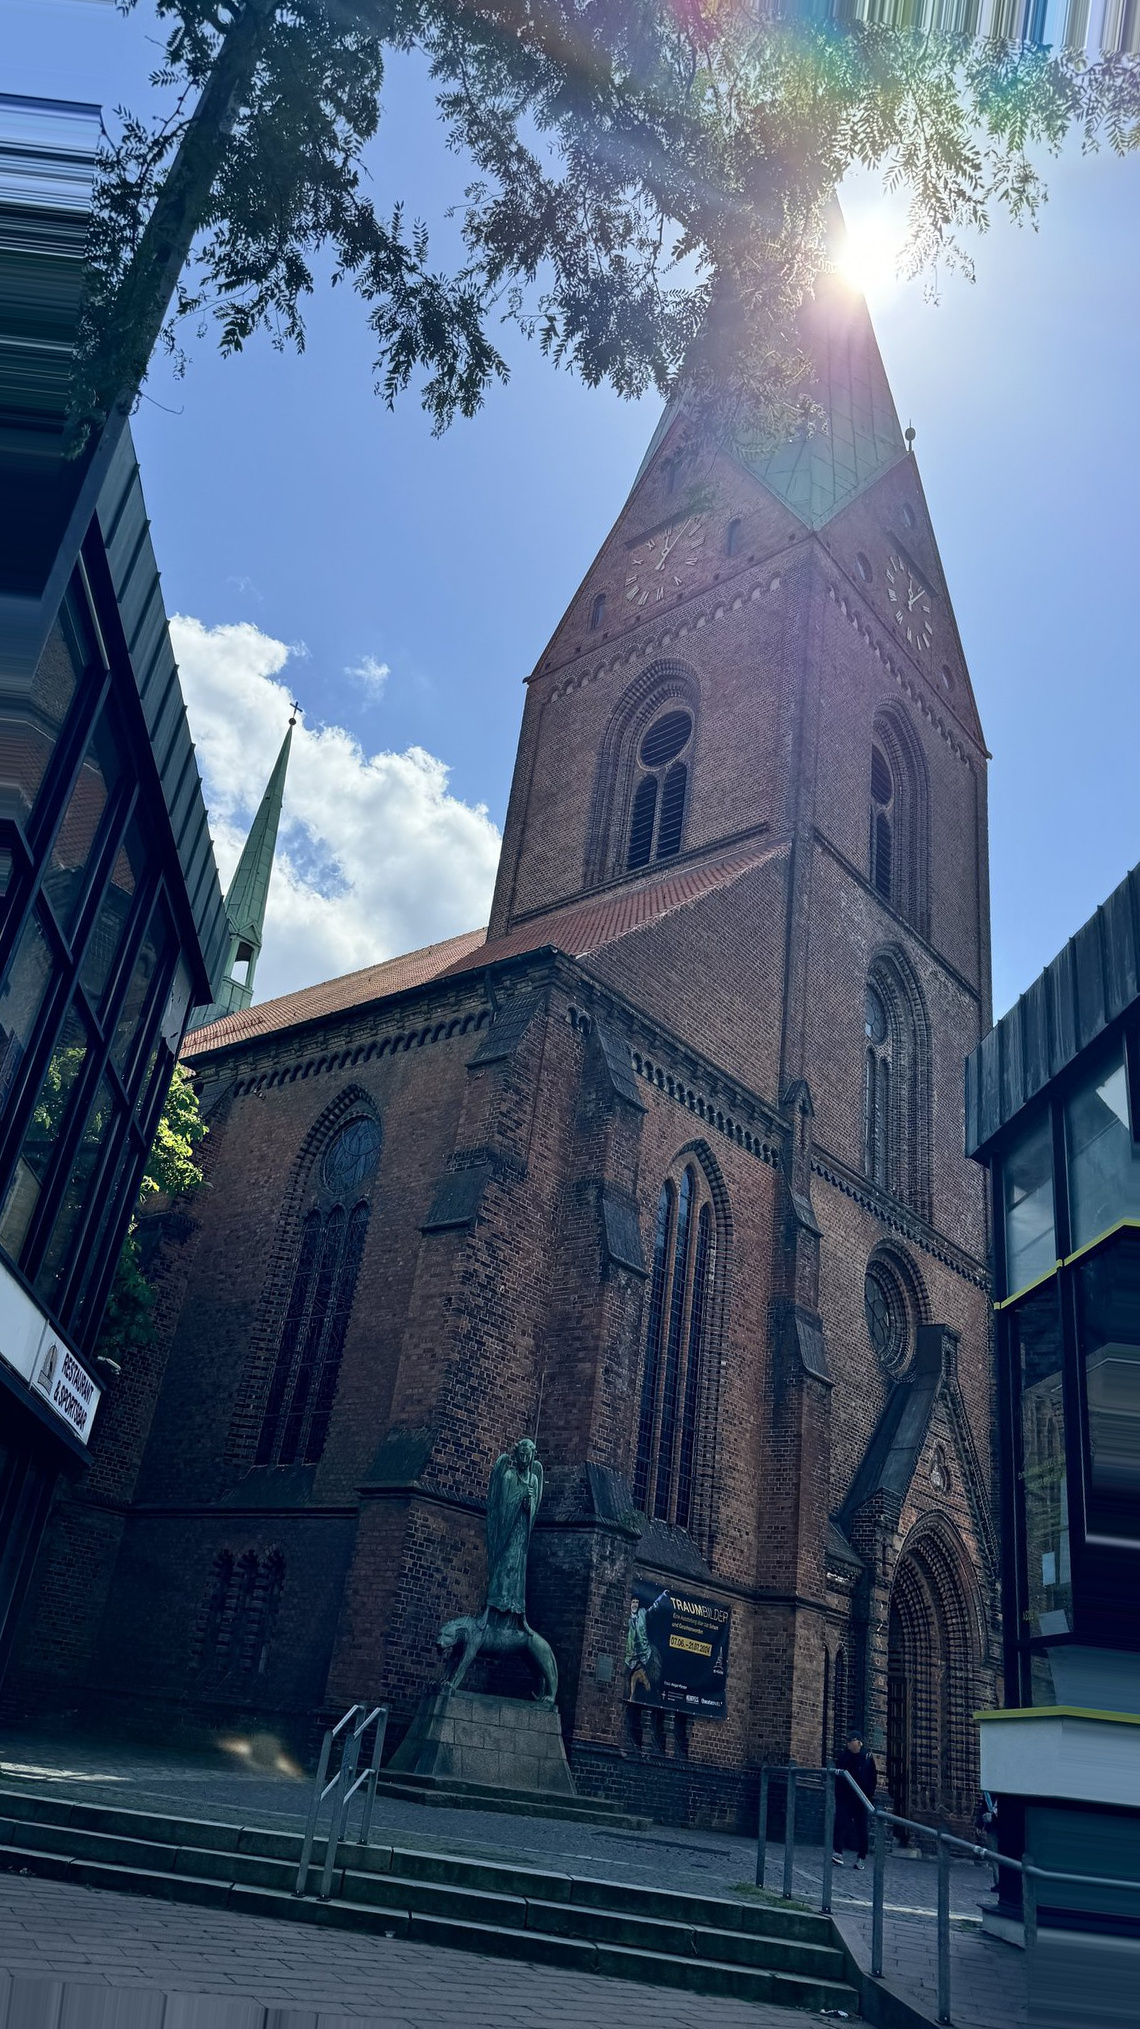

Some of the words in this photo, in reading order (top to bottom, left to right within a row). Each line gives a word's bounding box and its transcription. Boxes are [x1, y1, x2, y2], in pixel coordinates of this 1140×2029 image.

[62, 1352, 95, 1405] RESTAURANT
[53, 1379, 62, 1402] &
[59, 1384, 88, 1433] SPORTSBAR
[670, 1597, 729, 1623] TRAUMBILDER
